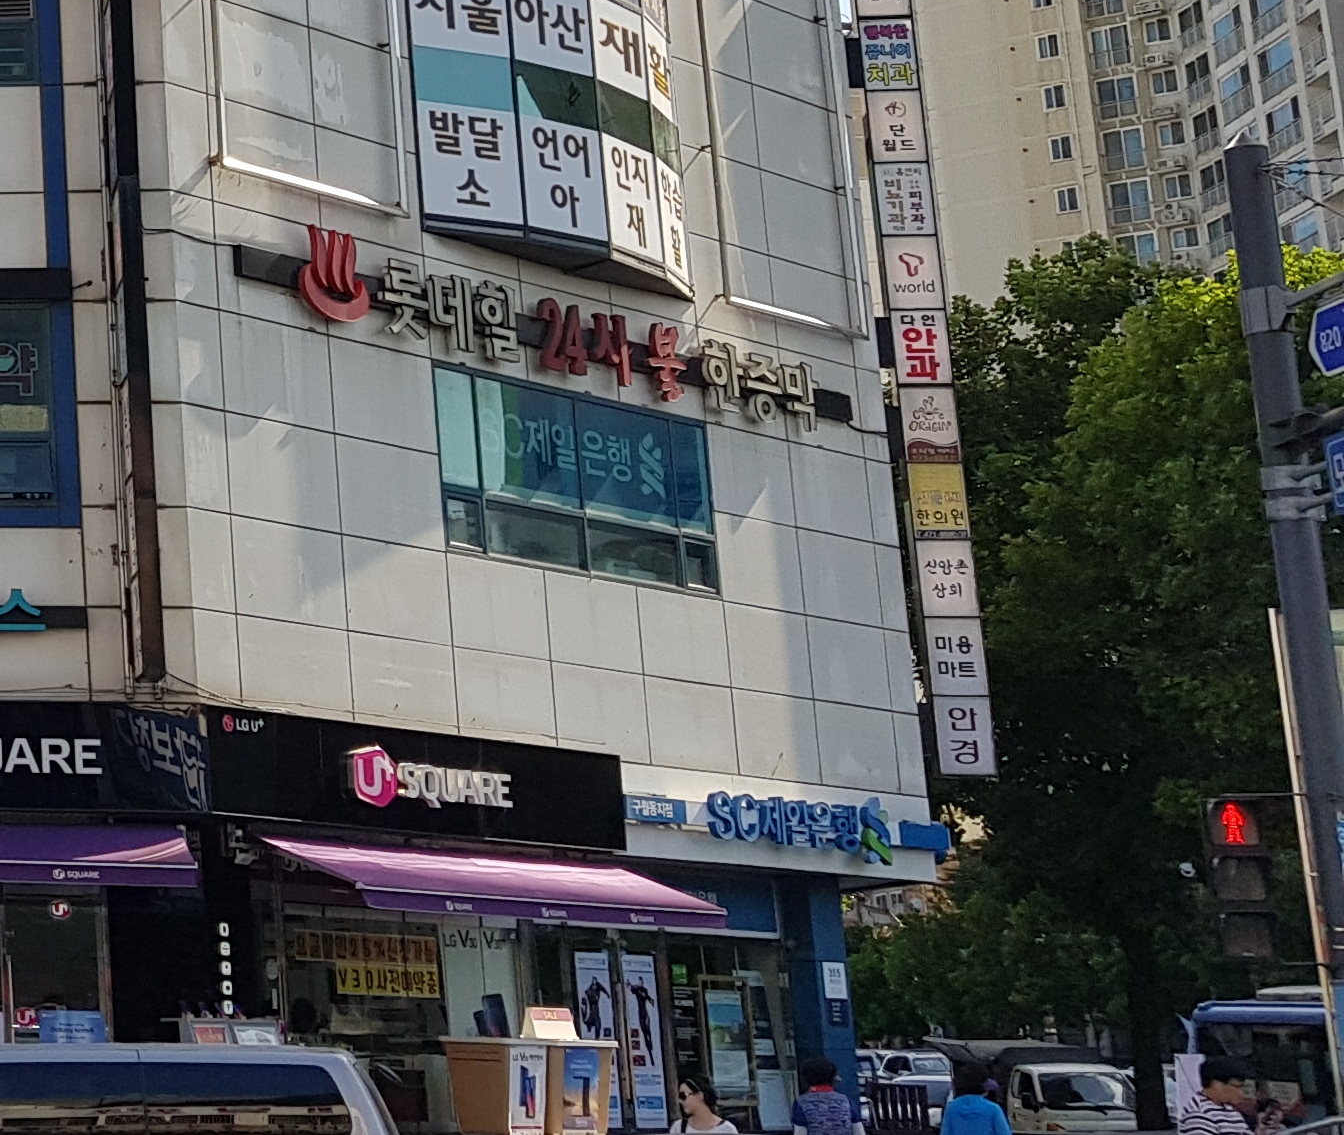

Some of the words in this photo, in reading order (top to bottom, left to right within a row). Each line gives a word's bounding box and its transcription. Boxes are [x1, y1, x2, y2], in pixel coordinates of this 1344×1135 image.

[867, 62, 915, 87] 치과
[429, 109, 505, 162] 발달
[532, 125, 592, 178] 언어
[612, 145, 651, 200] 인지
[893, 279, 936, 295] world
[377, 257, 521, 363] 롯데힐
[536, 296, 633, 388] 24시
[701, 337, 821, 432] 한증막
[901, 327, 941, 381] 안과
[1320, 325, 1342, 353] 820
[934, 635, 974, 655] 미용
[937, 661, 977, 679] 마트
[947, 707, 980, 765] 안경
[397, 762, 514, 809] SQUARE
